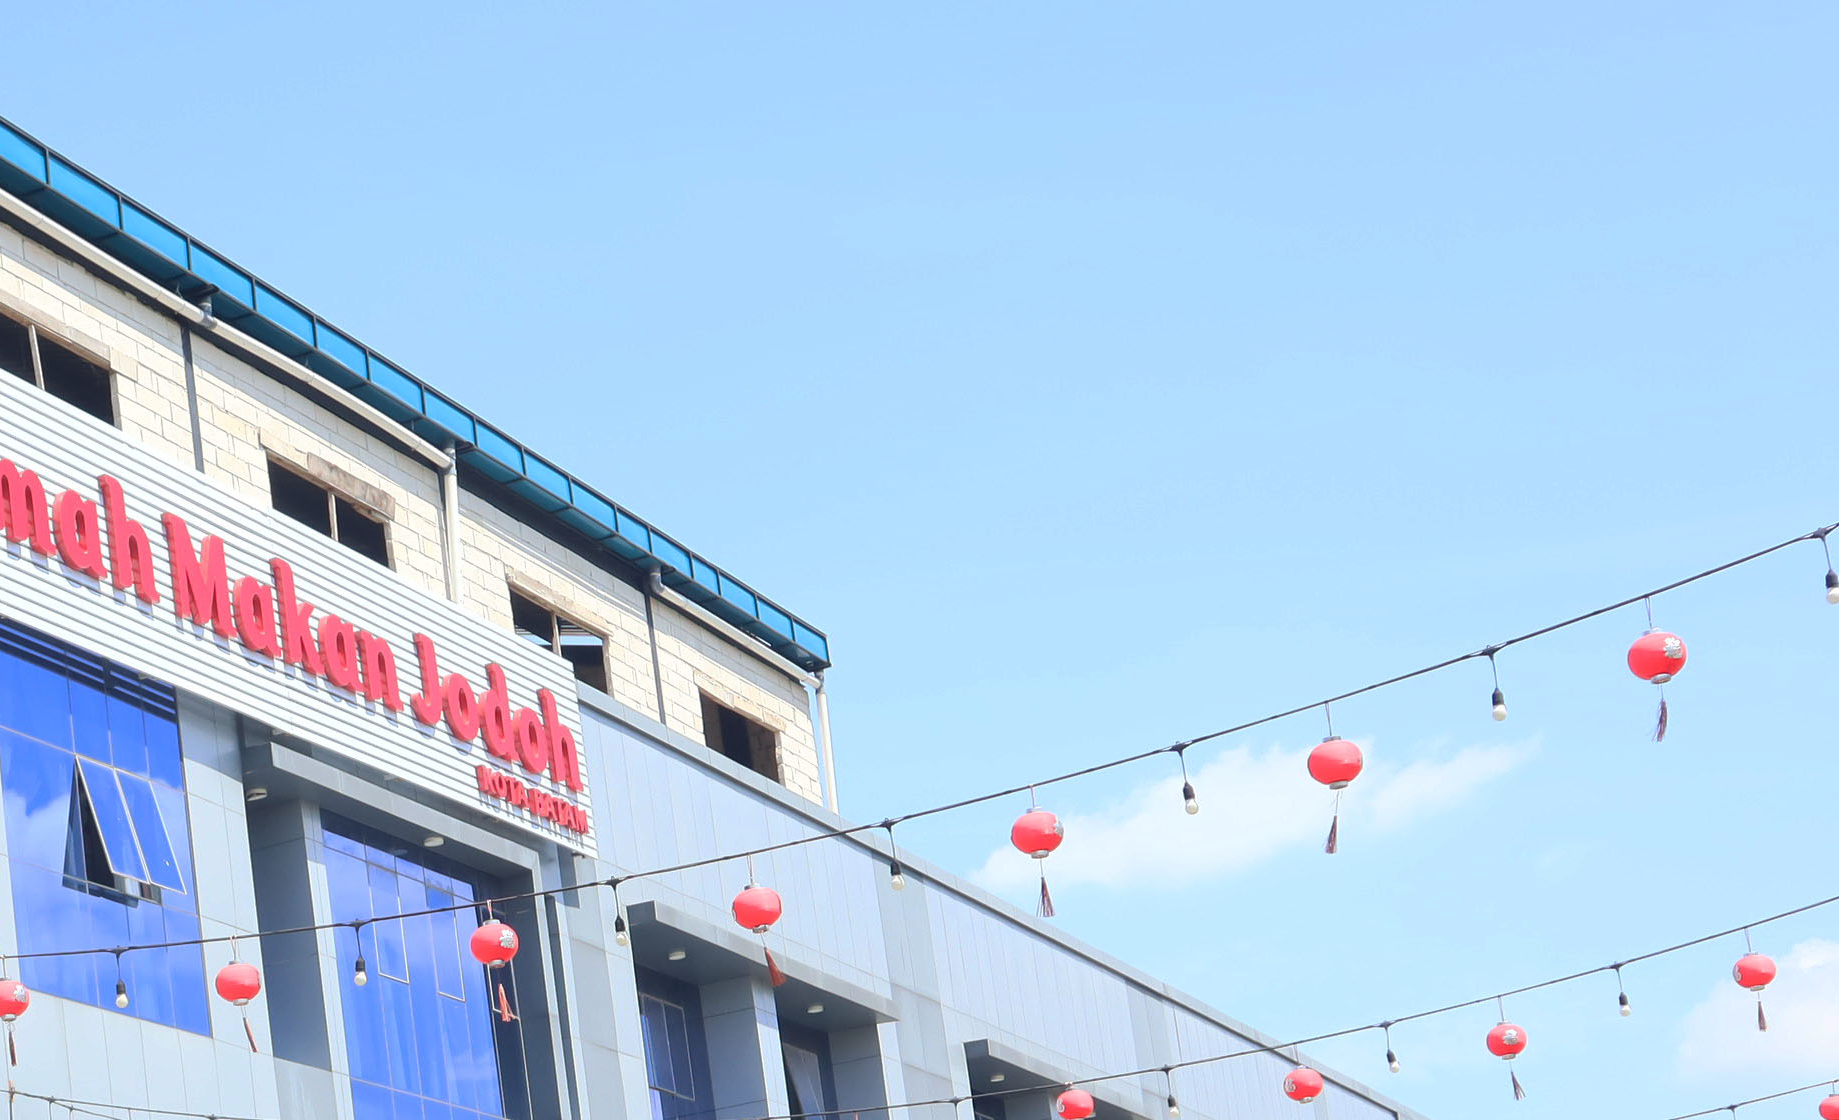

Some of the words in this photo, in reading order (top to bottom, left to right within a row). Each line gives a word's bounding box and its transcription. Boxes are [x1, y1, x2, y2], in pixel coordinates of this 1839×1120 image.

[163, 512, 404, 715] Makan
[410, 632, 585, 794] Jodoh
[476, 765, 529, 810] KOTA
[527, 788, 589, 834] BATAM
